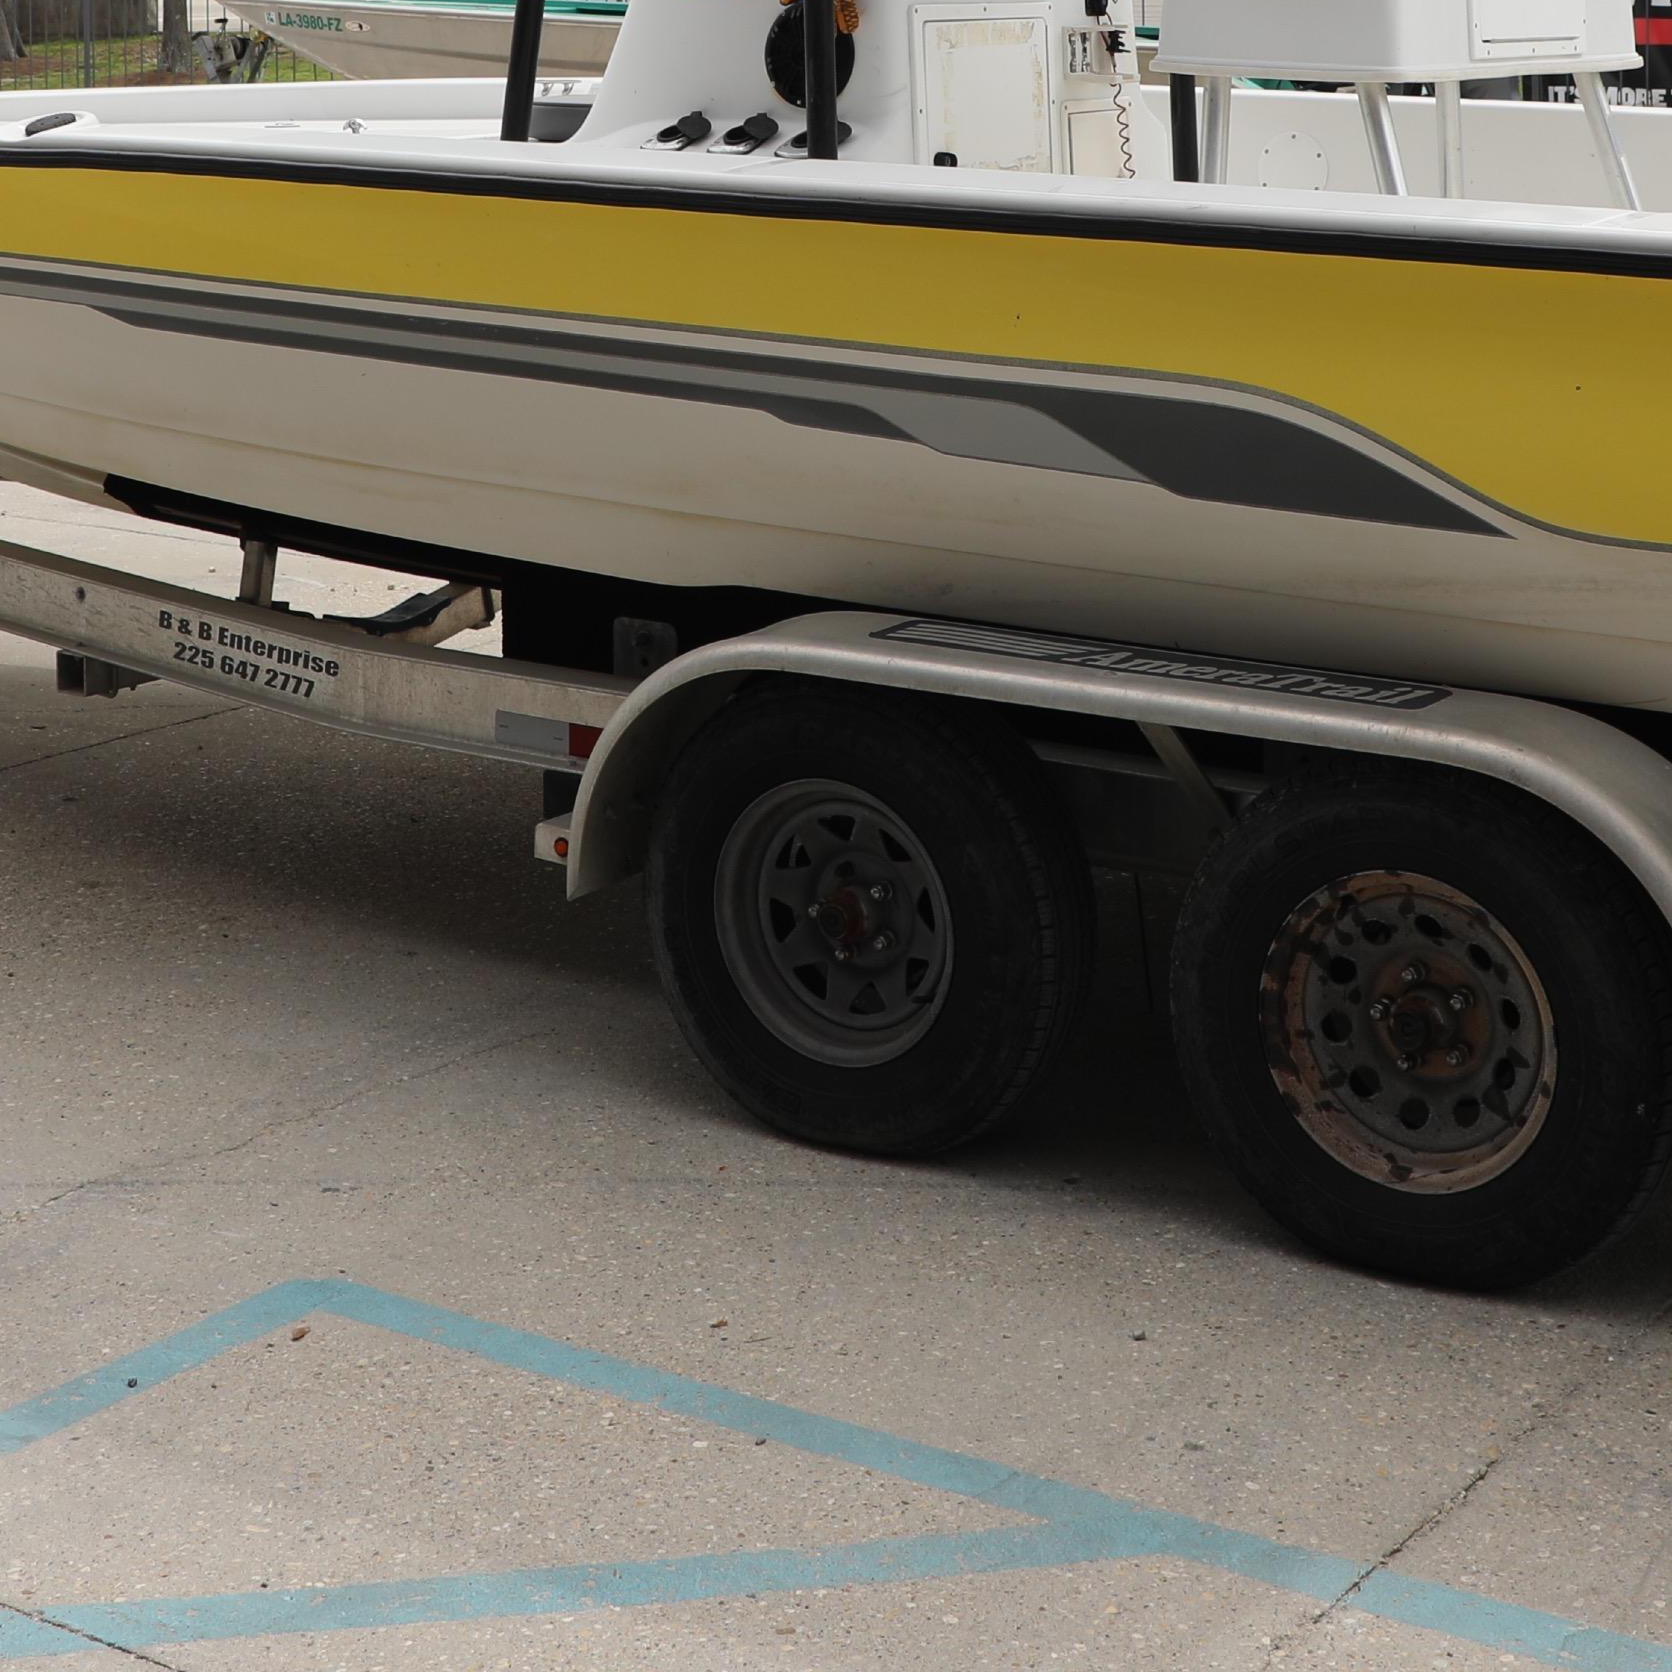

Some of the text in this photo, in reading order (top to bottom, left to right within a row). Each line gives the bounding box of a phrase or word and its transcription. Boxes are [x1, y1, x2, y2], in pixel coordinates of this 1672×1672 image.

[278, 12, 343, 32] LA-3980-FZ
[1602, 86, 1668, 107] MORE
[159, 610, 340, 678] B & B Enterprise
[173, 641, 316, 698] 225 647 2777
[1062, 649, 1435, 705] AmeraTrail
